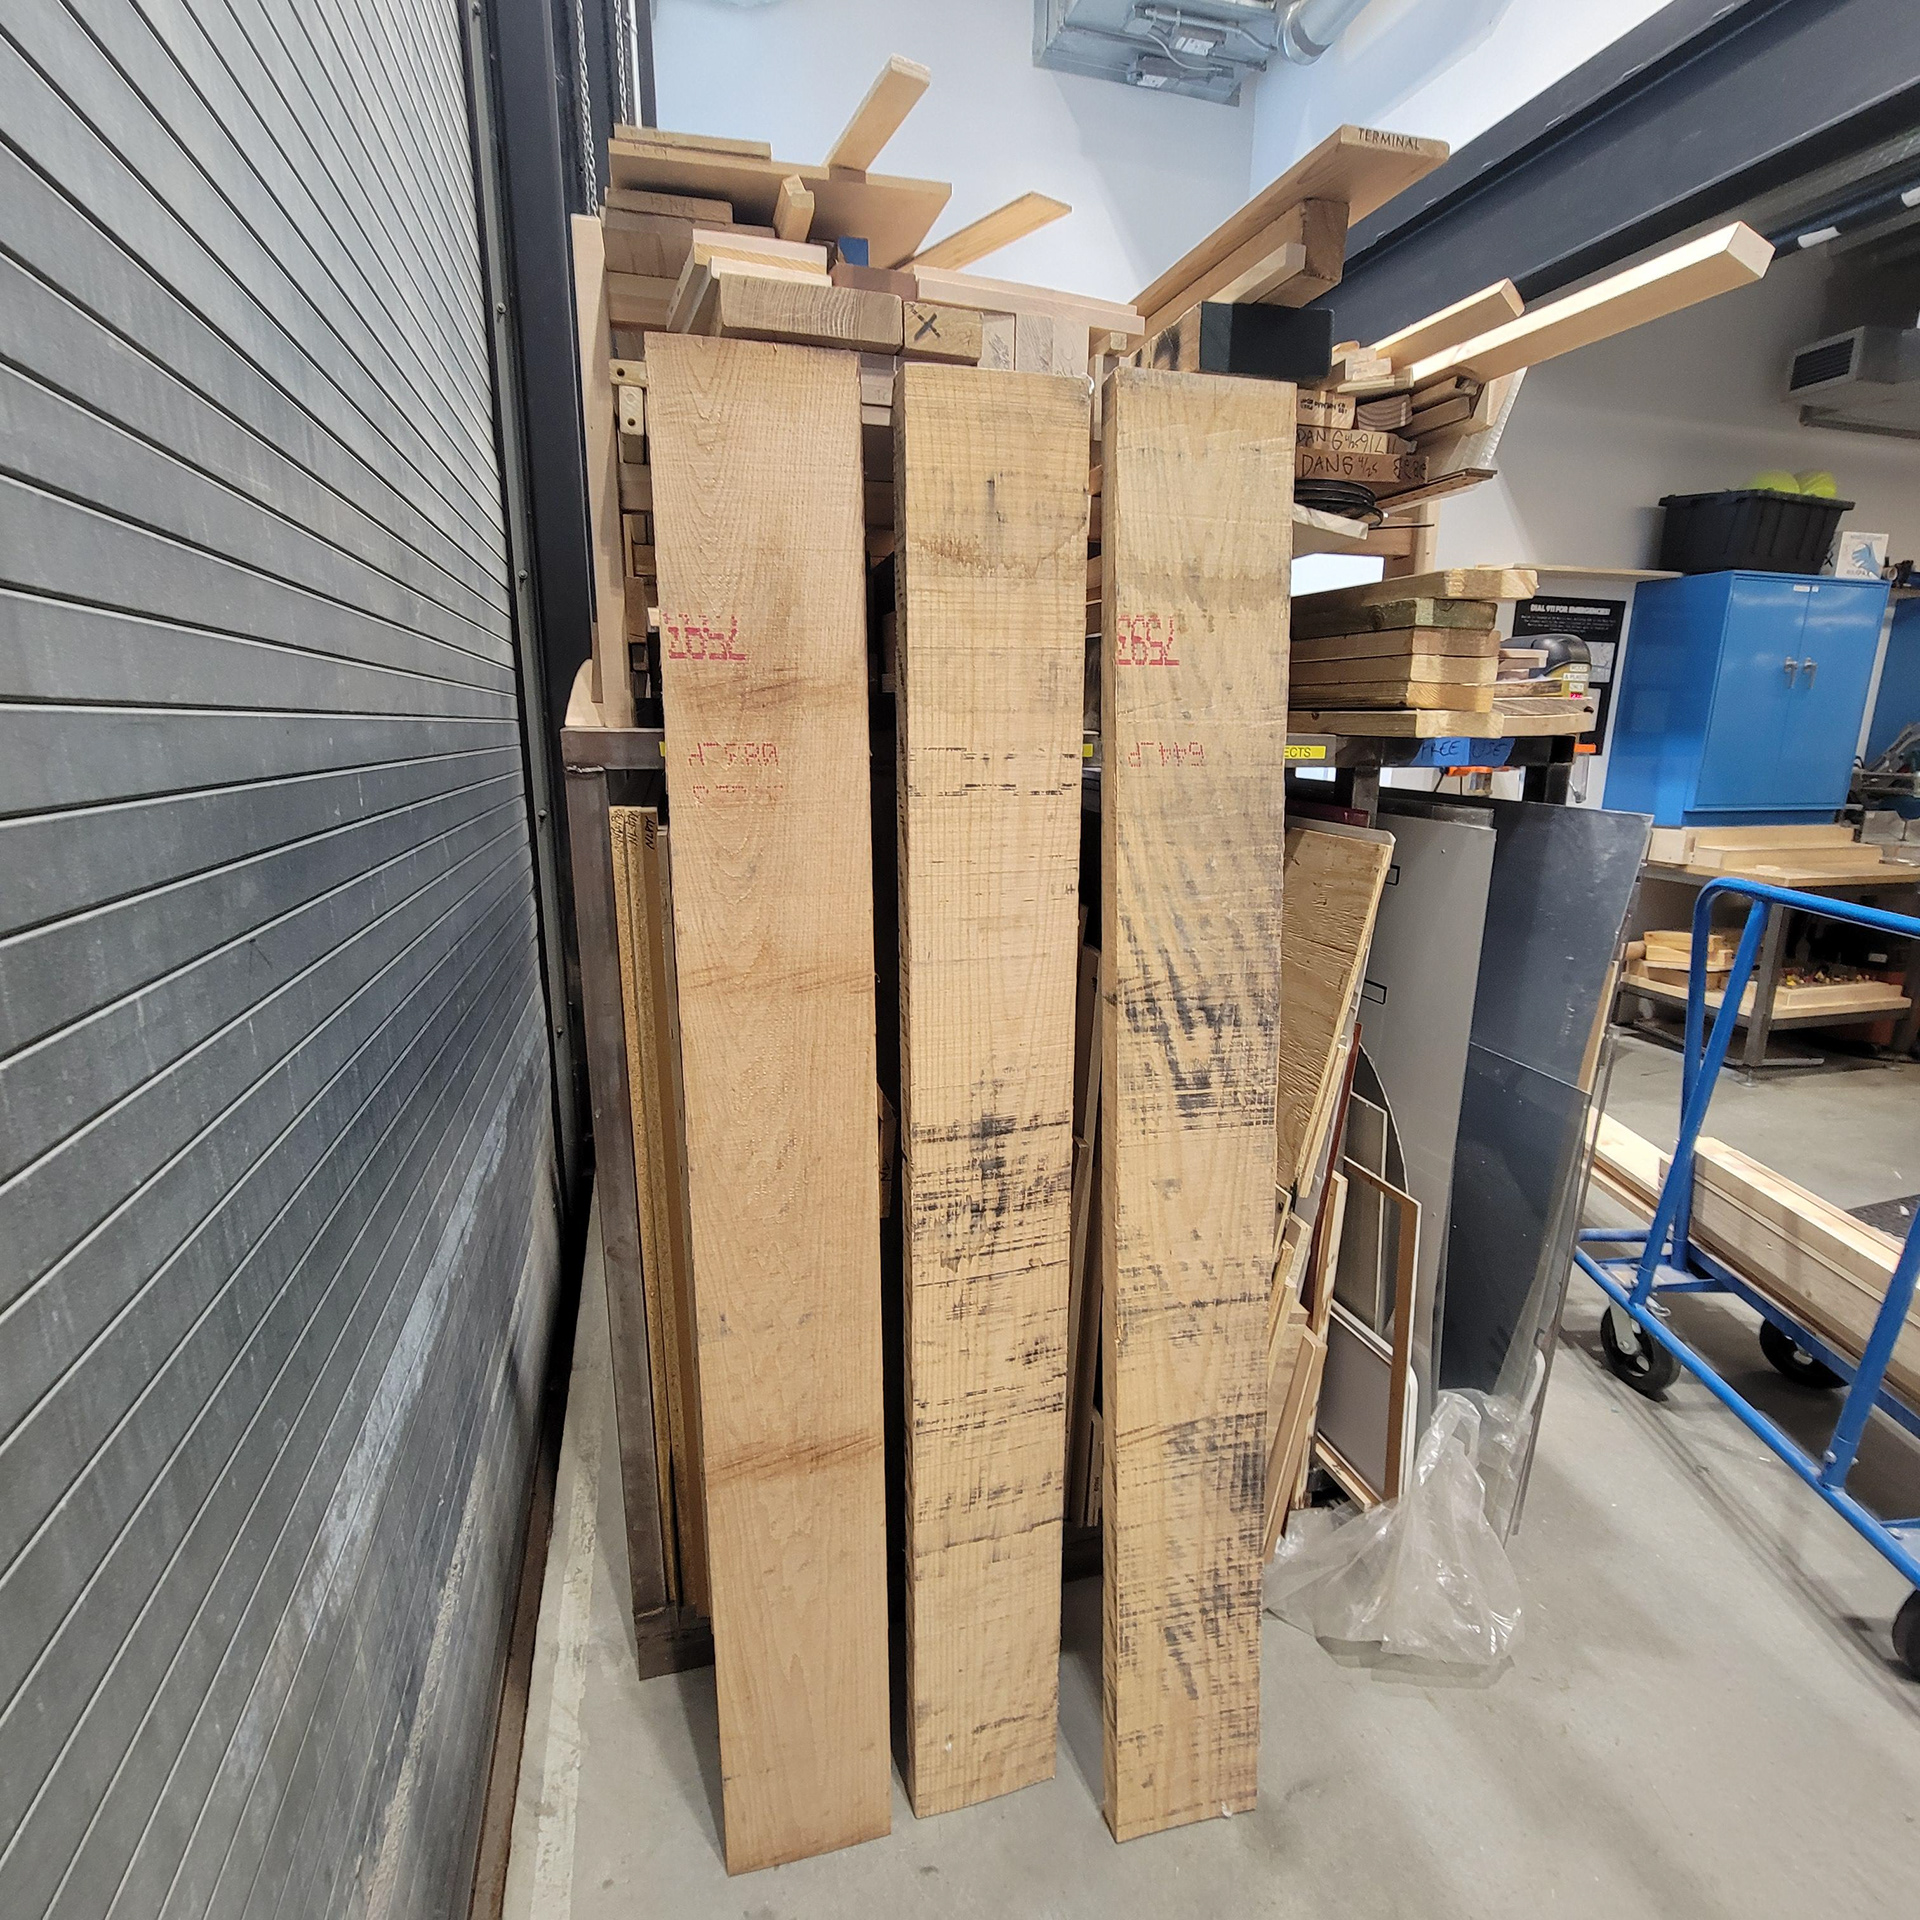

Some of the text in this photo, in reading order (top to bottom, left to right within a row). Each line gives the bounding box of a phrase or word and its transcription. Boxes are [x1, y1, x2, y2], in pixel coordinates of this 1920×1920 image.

[1358, 127, 1420, 150] TERMINAL
[1530, 603, 1545, 612] DIAL
[1555, 605, 1568, 614] FOR
[1421, 740, 1508, 760] FREE USE
